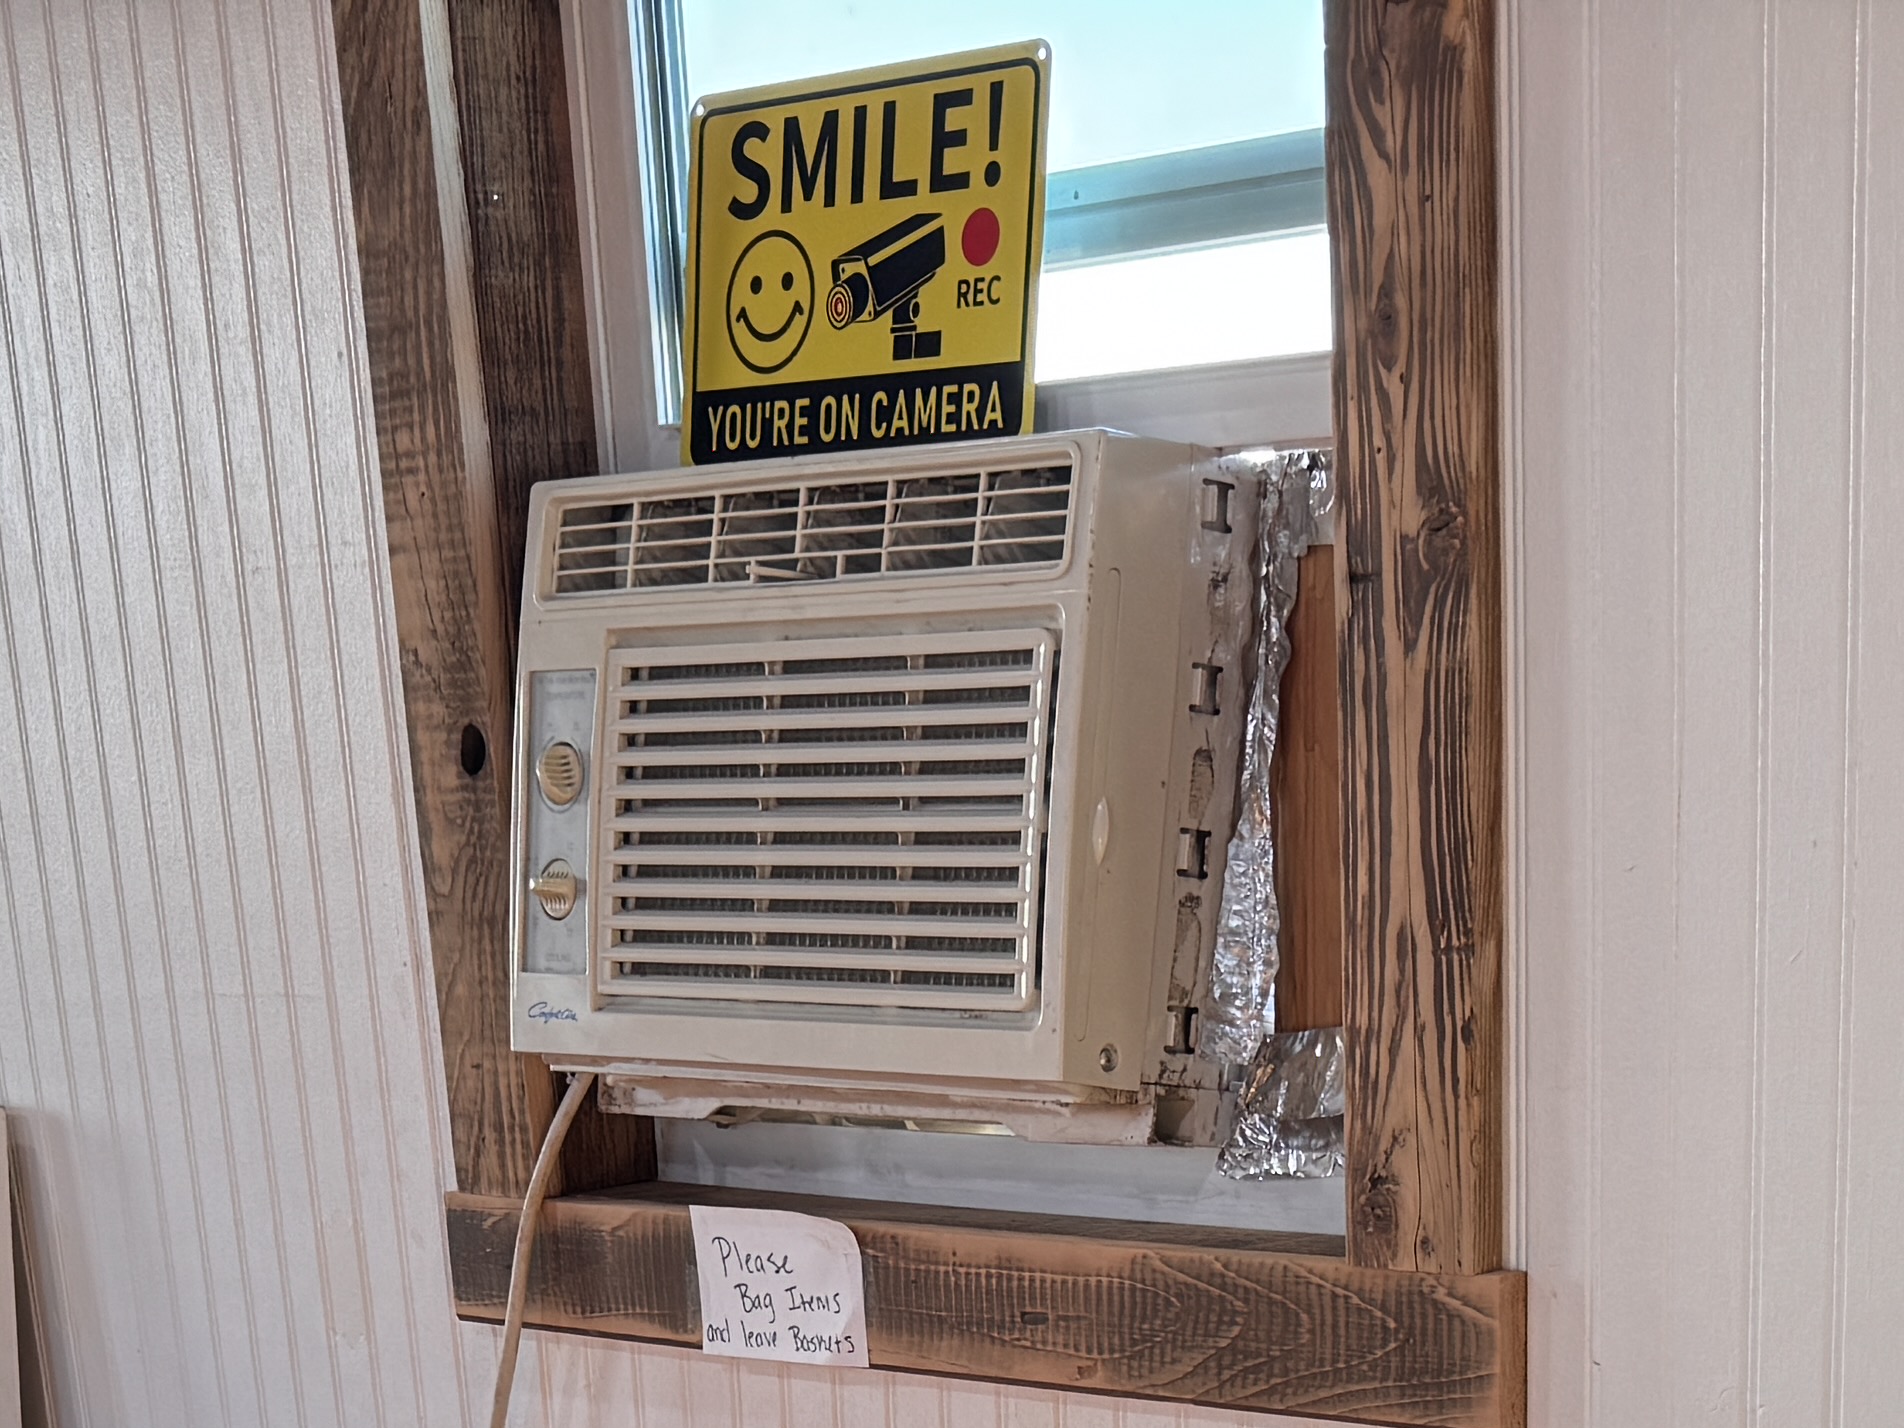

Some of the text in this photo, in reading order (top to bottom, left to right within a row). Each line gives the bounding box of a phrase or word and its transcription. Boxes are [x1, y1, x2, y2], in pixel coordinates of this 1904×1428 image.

[727, 80, 1004, 221] SMILE!
[957, 275, 1001, 309] REC
[708, 380, 1004, 451] YOU'RE ON CAMERA
[711, 1236, 794, 1278] Please
[733, 1283, 841, 1324] Bag Items
[706, 1318, 855, 1354] and leave Baskets
